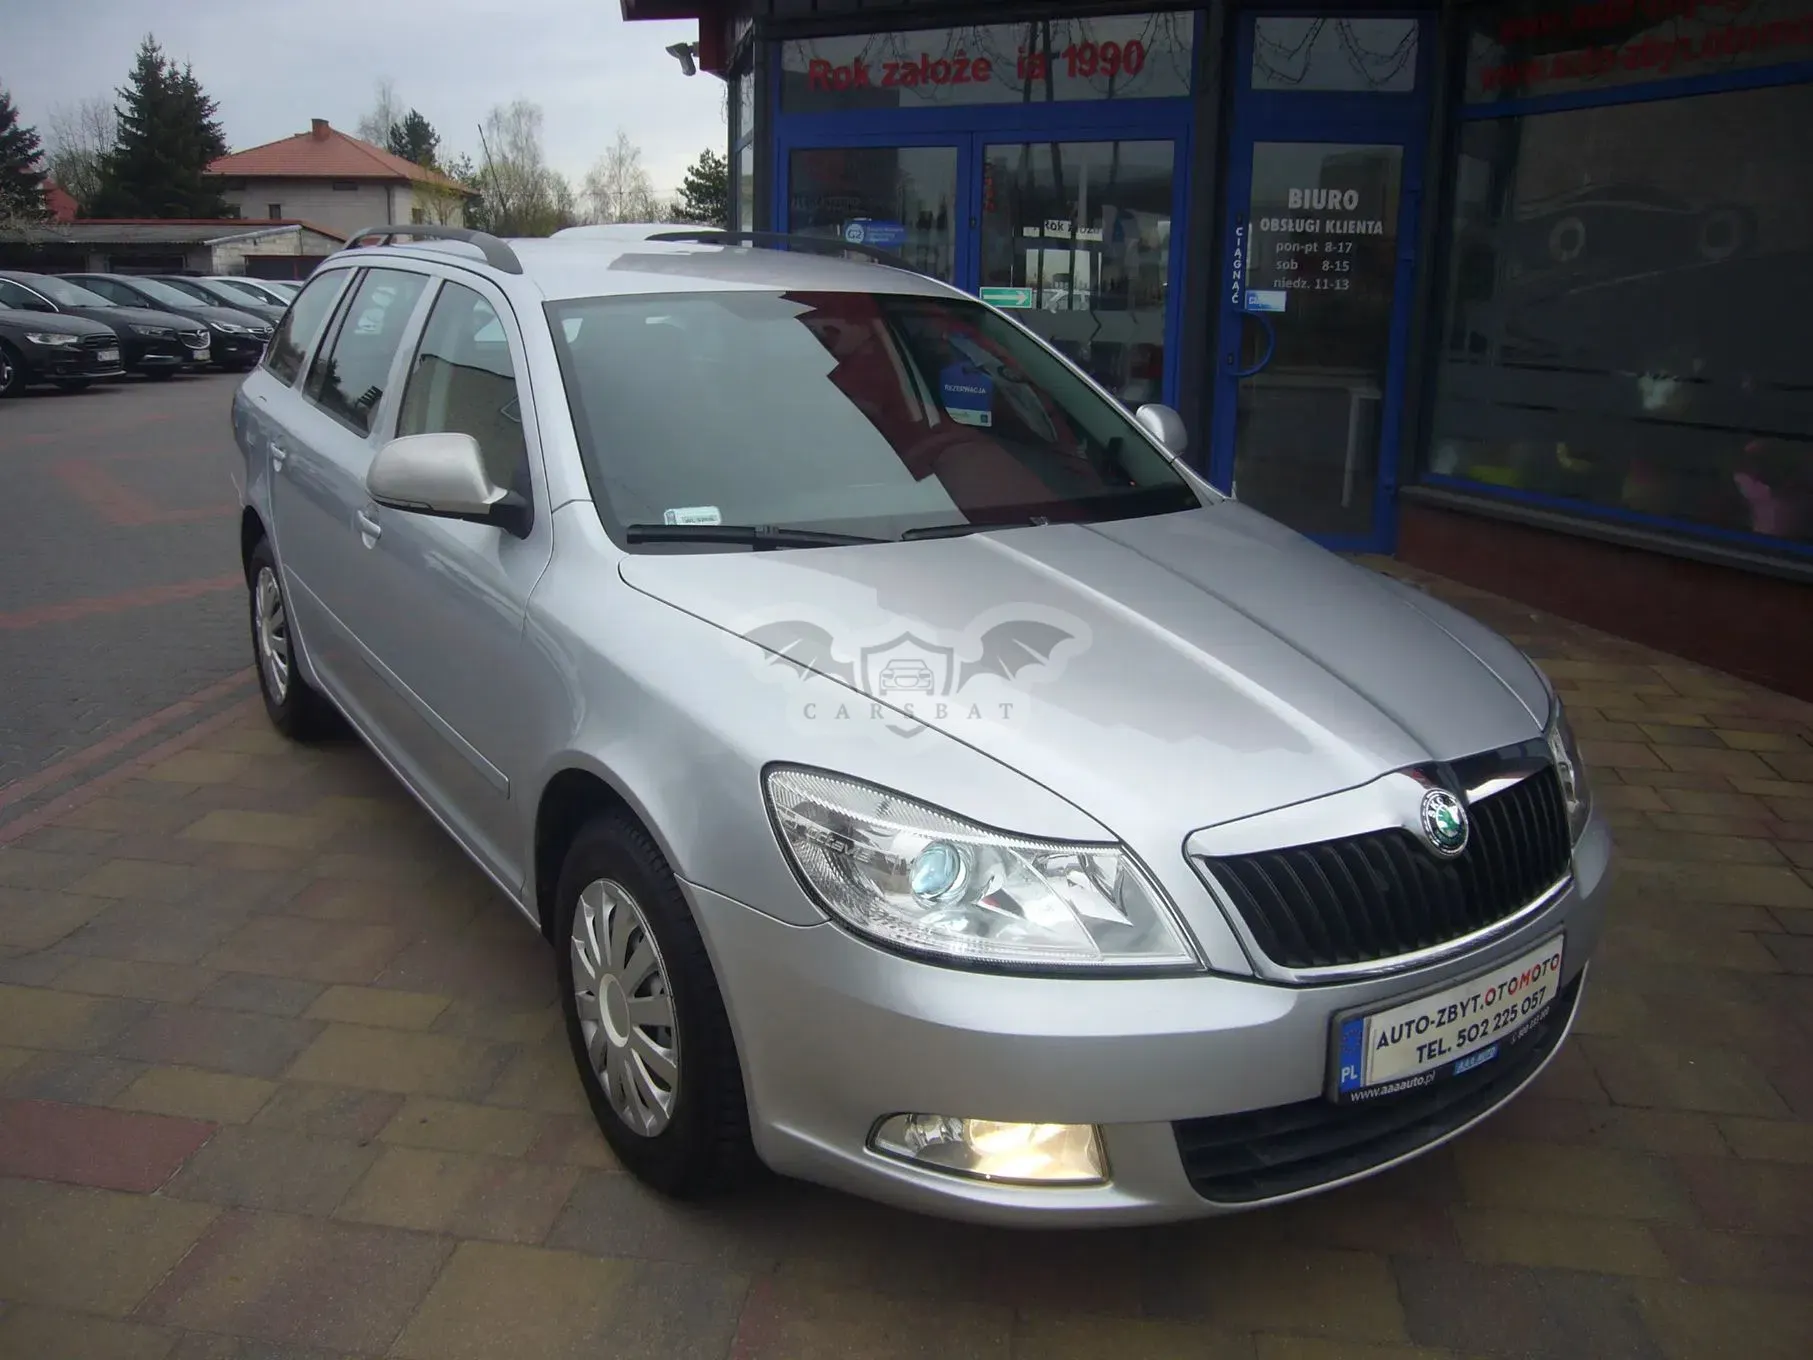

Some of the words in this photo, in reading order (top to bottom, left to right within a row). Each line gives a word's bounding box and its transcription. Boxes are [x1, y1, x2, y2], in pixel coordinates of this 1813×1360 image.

[808, 56, 870, 93] Rok
[1062, 39, 1145, 78] 1990
[1288, 188, 1359, 210] BIURO
[1260, 218, 1320, 233] OBSŁUGI
[1325, 219, 1383, 235] KLIENTA
[1275, 242, 1319, 253] pon-pt
[1324, 242, 1352, 253] 8-17
[1276, 259, 1299, 271] sob
[1321, 260, 1350, 271] 8-15
[1273, 277, 1311, 290] niedz.
[1314, 279, 1350, 290] 11-13
[944, 384, 986, 394] REZERWACJA
[1376, 953, 1560, 1050] AUTO-ZBYT.OTOMOTO
[1416, 1037, 1452, 1063] TEL.
[1456, 1018, 1489, 1048] 502
[1492, 1003, 1518, 1032] 225
[1521, 986, 1546, 1015] 057
[1341, 1064, 1358, 1083] PL
[1350, 1070, 1436, 1101] www.aaaauto.pl
